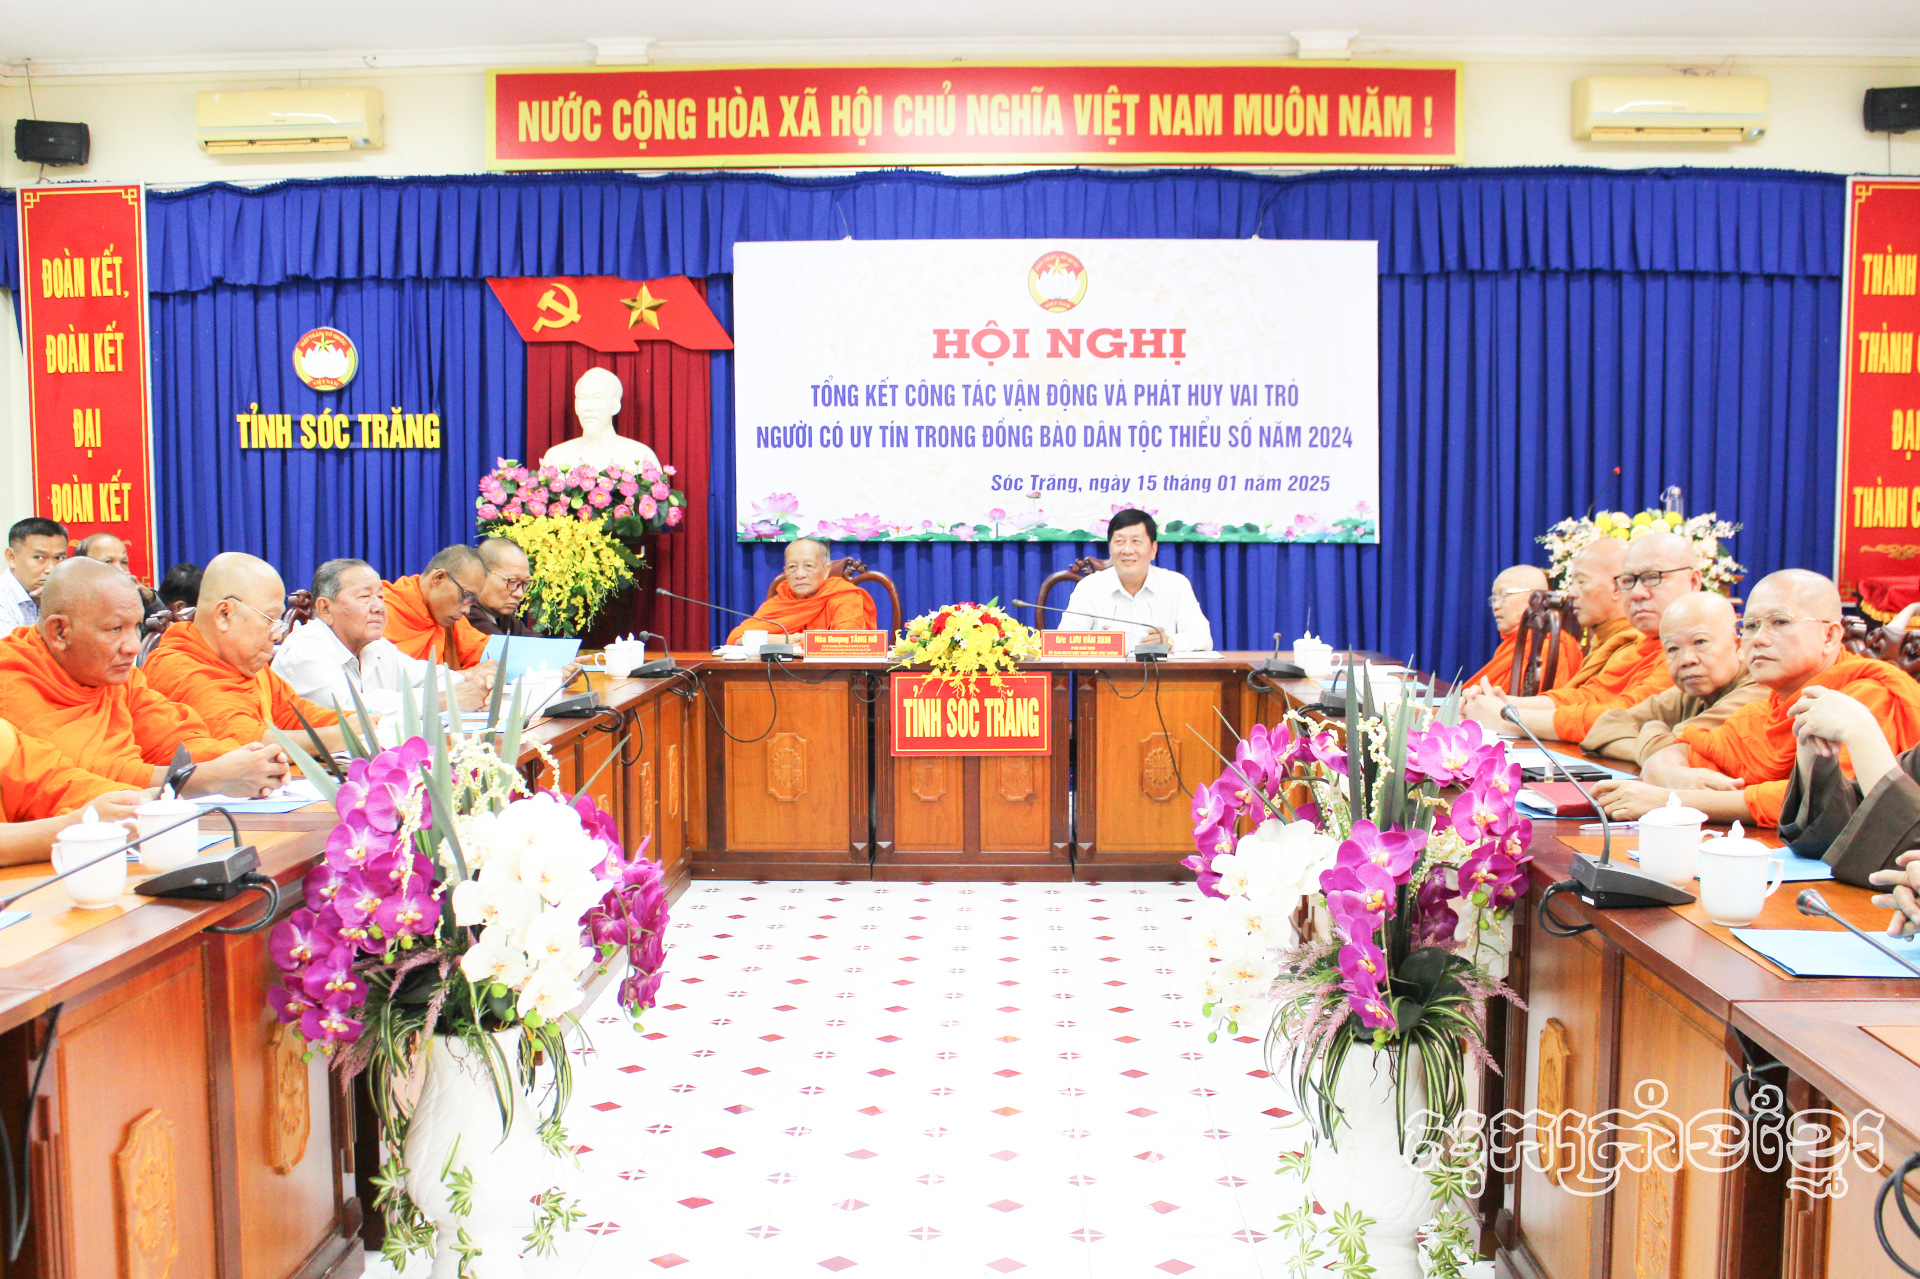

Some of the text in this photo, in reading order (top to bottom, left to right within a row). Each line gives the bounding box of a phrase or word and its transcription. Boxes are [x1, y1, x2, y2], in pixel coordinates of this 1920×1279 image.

[518, 80, 1433, 150] NƯỚC CỘNG HÒA XÃ HỘI CHỦ NGHĨA VIỆT NAM MUÔN NĂM !
[42, 243, 130, 299] ĐOÀN KẾT,
[1862, 244, 1918, 296] THÀNH
[46, 320, 124, 374] ĐOÀN KẾT
[933, 319, 1187, 367] HỘI NGHỊ
[1859, 322, 1914, 374] THÀNH
[811, 375, 1299, 411] TỔNG KẾT CÔNG TÁC VẬN ĐỘNG VÀ PHÁT HUY VAI TRÒ
[72, 408, 102, 458] ĐẠI
[236, 402, 440, 449] TỈNH SÓC TRĂNG
[756, 416, 1353, 453] NGƯỜI CÓ UY TÍN TRONG ĐỒNG BÀO DÂN TỘC THIỂU SỐ NĂM 2024
[50, 469, 132, 524] ĐOÀN KẾT
[990, 474, 1331, 493] Sóc Trăng, ngày 15 tháng 01 năm 2025
[1853, 476, 1909, 528] THÀNH
[903, 685, 1040, 738] TỈNH SÓC TRĂNG
